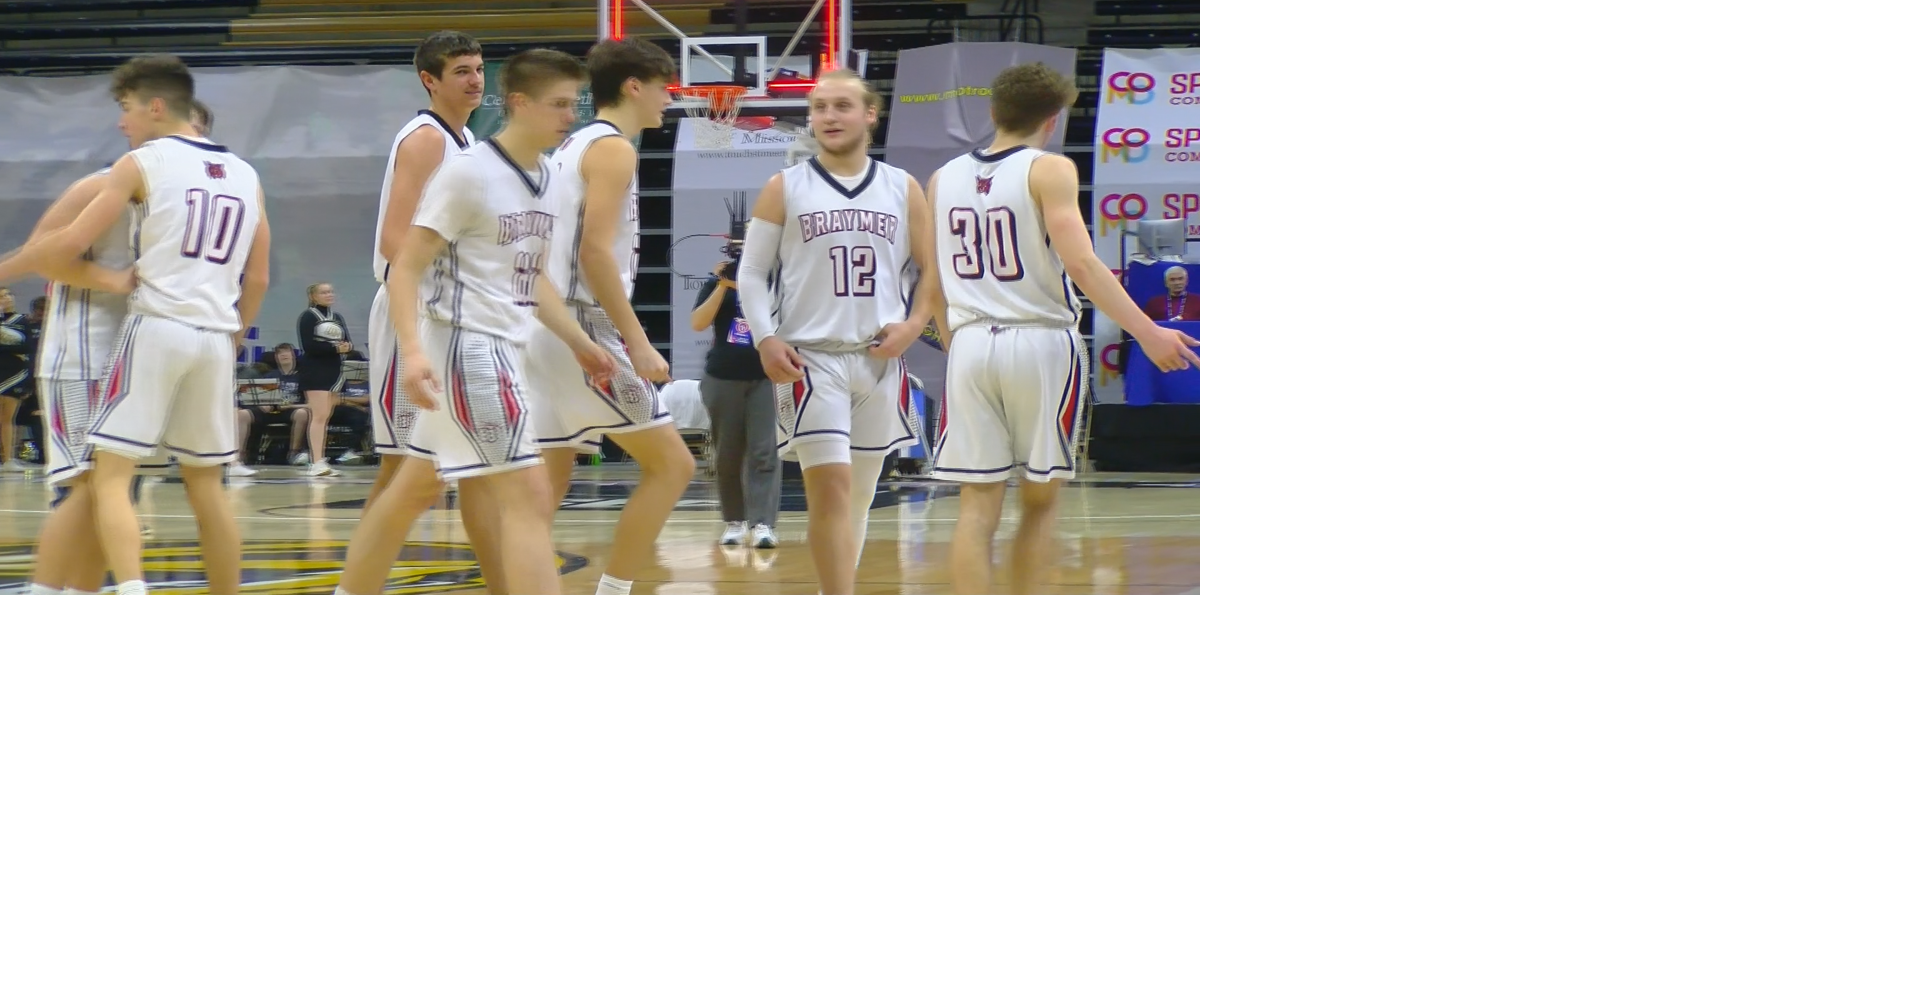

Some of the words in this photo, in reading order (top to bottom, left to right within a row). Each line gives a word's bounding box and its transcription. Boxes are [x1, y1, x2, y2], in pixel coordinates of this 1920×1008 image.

[1164, 128, 1200, 148] SP
[181, 188, 245, 265] 10
[798, 209, 898, 245] BRAYMER
[1163, 193, 1200, 220] SP
[949, 206, 1024, 282] 30
[829, 246, 876, 297] 12
